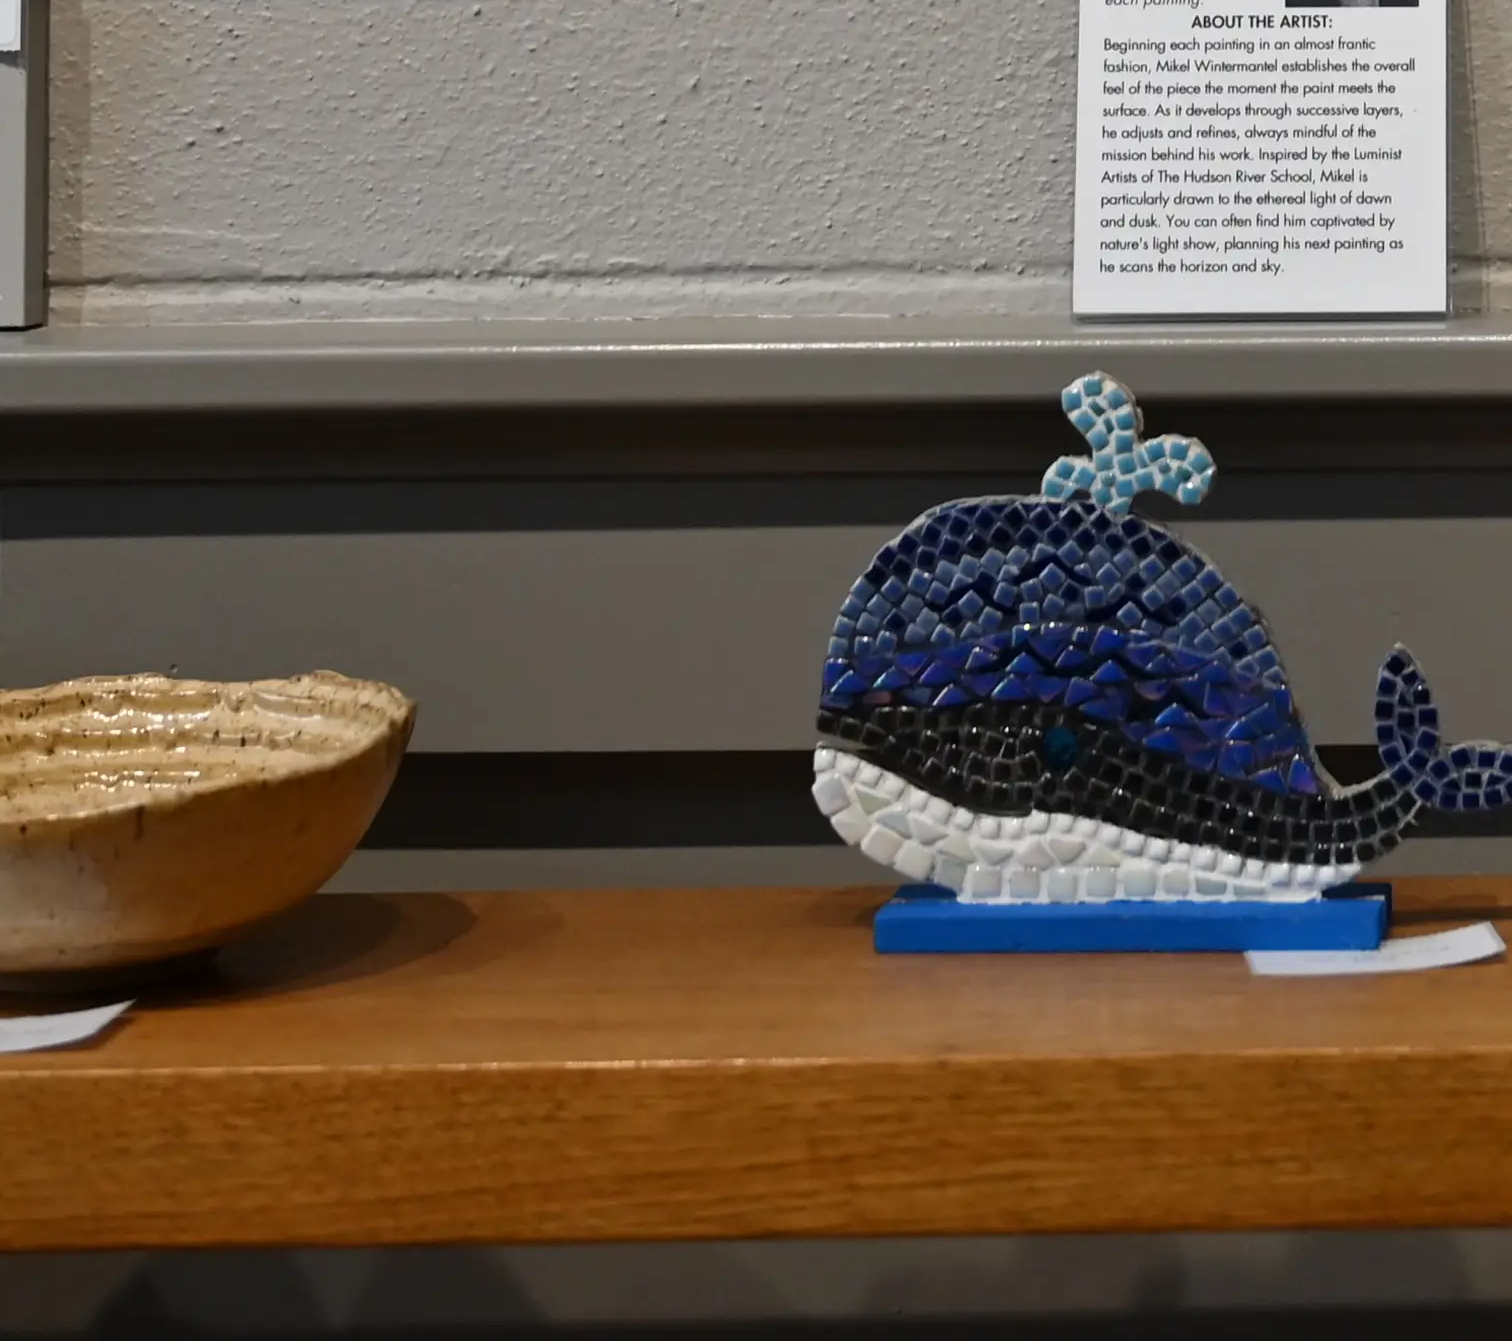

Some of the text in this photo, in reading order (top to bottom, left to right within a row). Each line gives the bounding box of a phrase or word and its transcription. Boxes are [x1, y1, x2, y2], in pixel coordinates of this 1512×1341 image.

[1191, 14, 1332, 28] ABOUT THE ARTIST:
